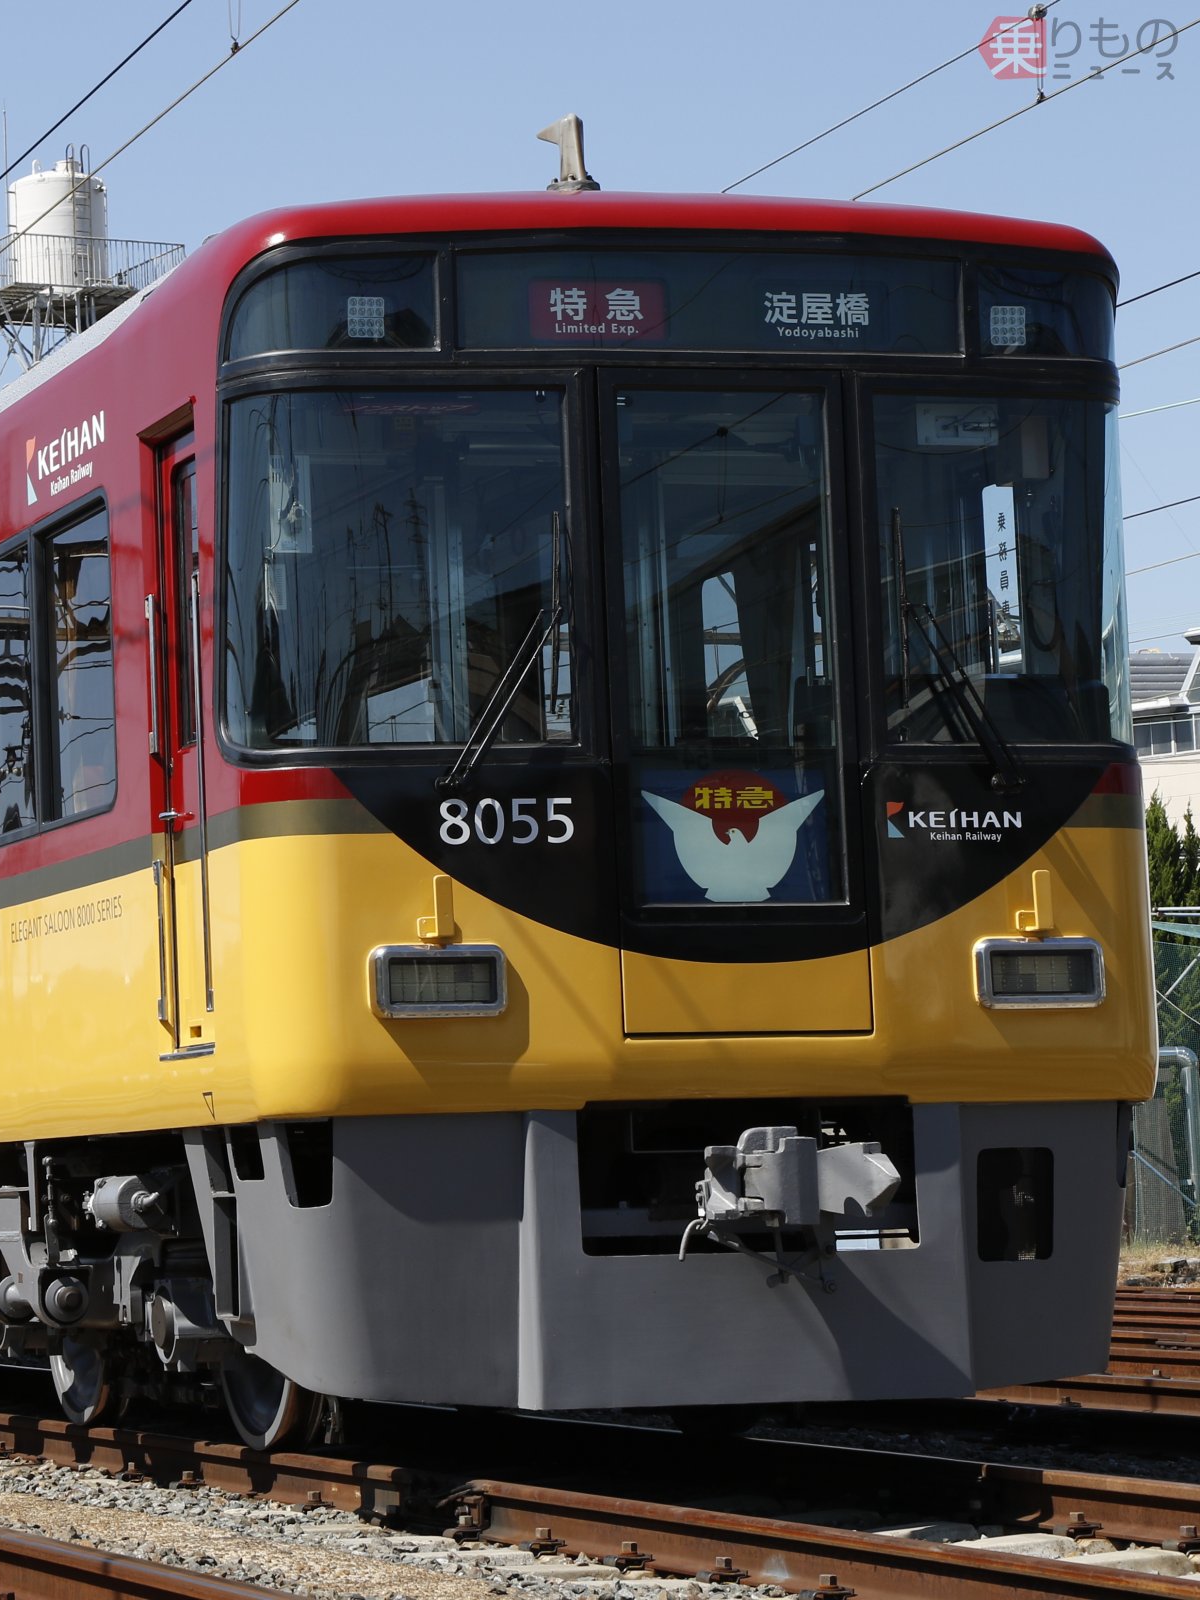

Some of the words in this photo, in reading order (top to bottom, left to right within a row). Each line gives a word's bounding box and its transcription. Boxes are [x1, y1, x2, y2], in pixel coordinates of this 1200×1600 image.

[550, 287, 644, 321] 特急
[764, 291, 870, 327] 淀屋橋
[555, 322, 606, 335] Limited
[611, 323, 640, 338] Exp.
[777, 326, 860, 340] Yodoyabashi
[38, 410, 105, 480] KEIHAN
[50, 476, 70, 496] Keihan
[70, 461, 93, 486] Railway
[694, 786, 774, 809] 特急
[439, 797, 575, 845] 8055
[908, 808, 1022, 828] KEIHAN
[930, 831, 963, 842] Keihan
[965, 831, 1002, 843] Railway
[11, 916, 43, 943] ELEGANT
[44, 908, 76, 936] SALOON
[77, 902, 97, 928] 8000
[96, 895, 123, 923] SERIES
